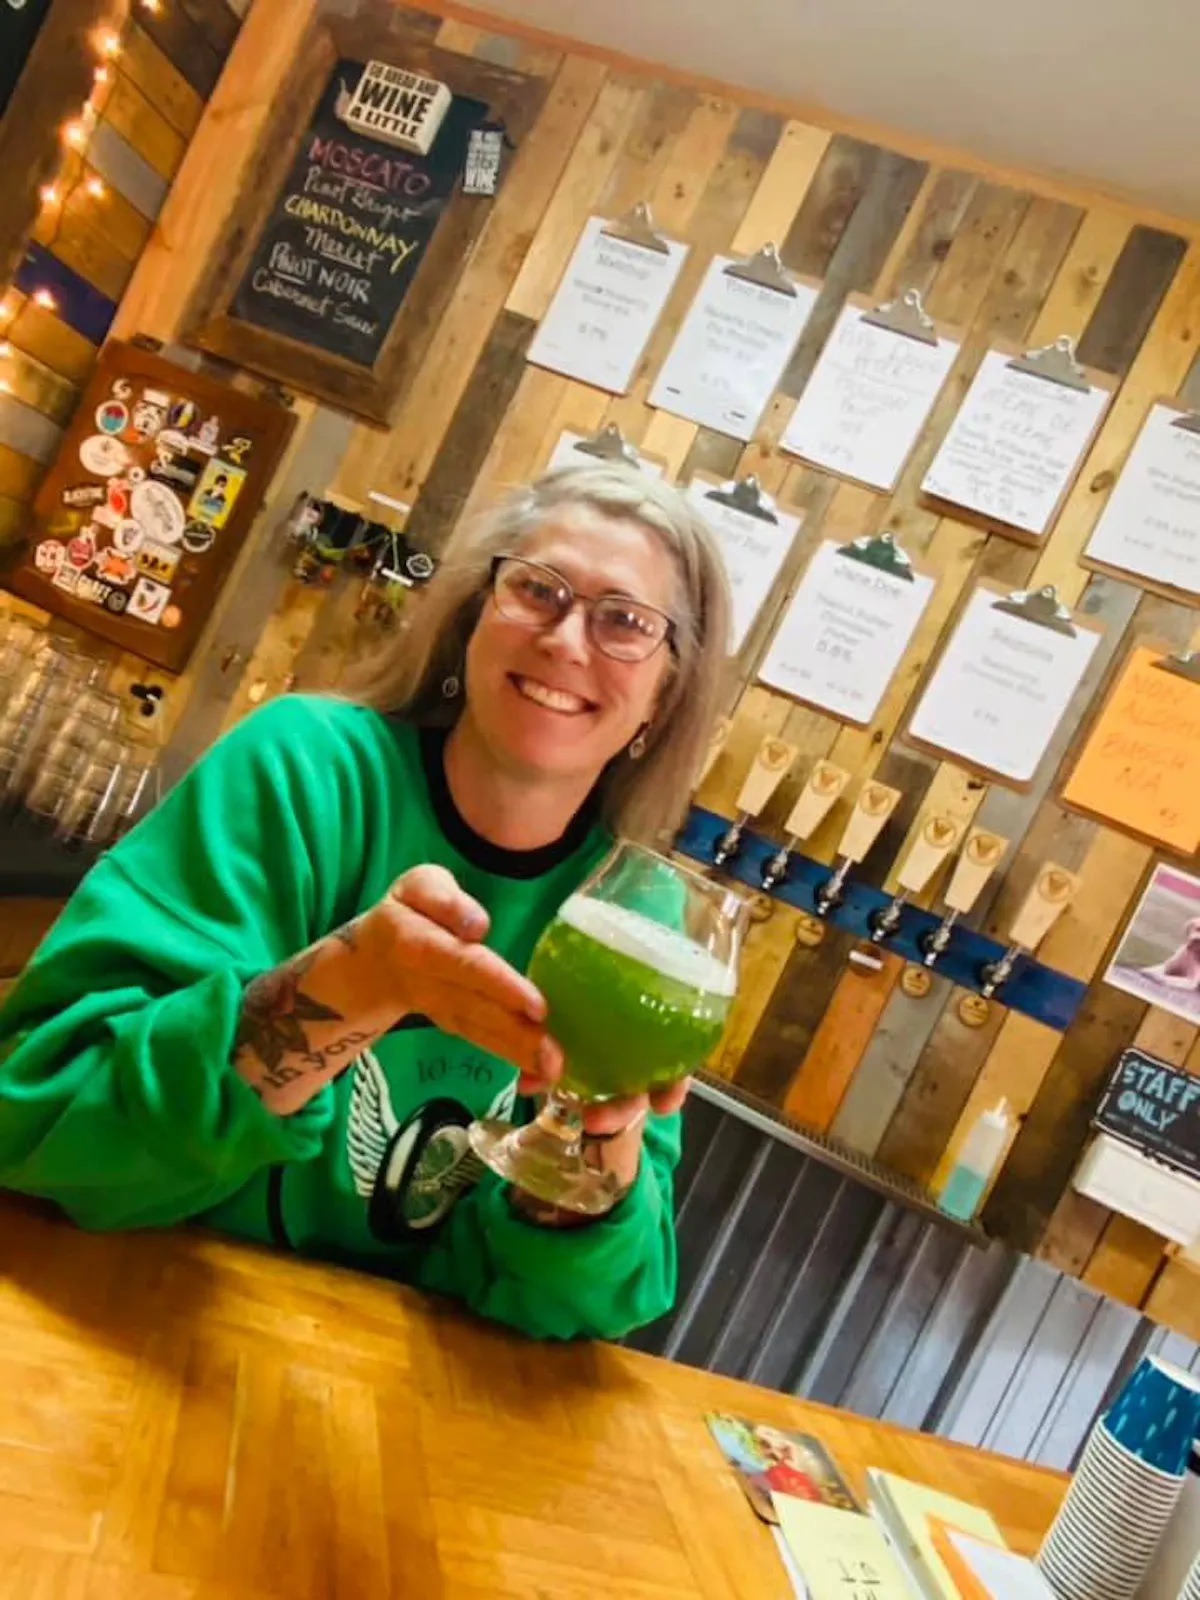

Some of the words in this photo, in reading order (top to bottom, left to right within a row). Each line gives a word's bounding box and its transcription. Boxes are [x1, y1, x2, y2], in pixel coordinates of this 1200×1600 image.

[350, 106, 361, 122] A
[363, 110, 419, 139] LITTLE
[358, 79, 432, 124] WINE
[309, 139, 430, 195] MOSCATO
[285, 195, 416, 274] CHARDONNAY
[318, 268, 372, 303] NOIR
[1121, 1061, 1200, 1112] STAFF
[1117, 1090, 1178, 1132] ONLY
